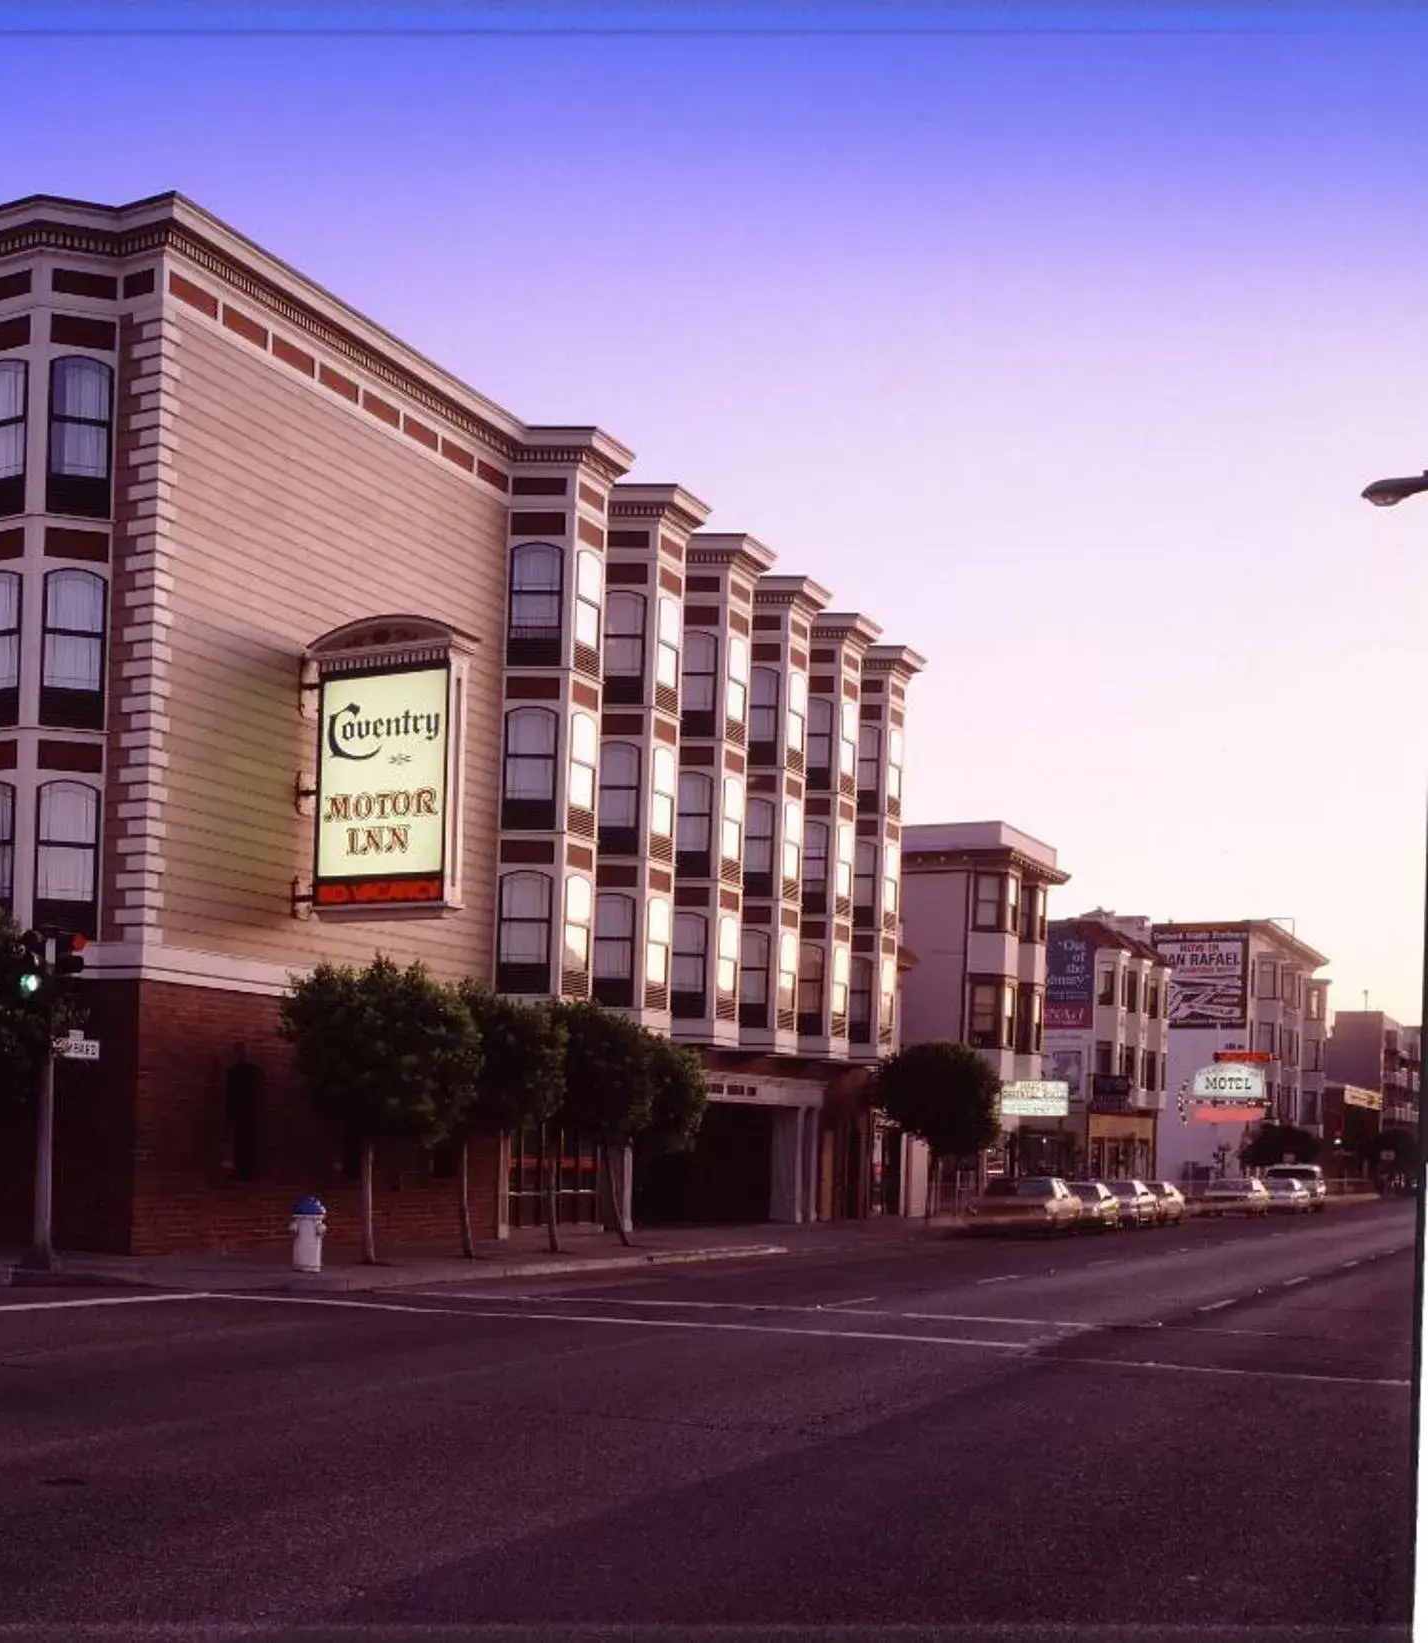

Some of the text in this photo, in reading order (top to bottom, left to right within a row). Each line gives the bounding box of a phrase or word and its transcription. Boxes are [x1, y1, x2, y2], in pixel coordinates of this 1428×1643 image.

[328, 702, 440, 760] Coventry
[324, 787, 437, 823] MOTOR
[346, 825, 412, 856] INN
[1190, 951, 1240, 965] RAFAEL
[1205, 1077, 1252, 1090] MOTEL
